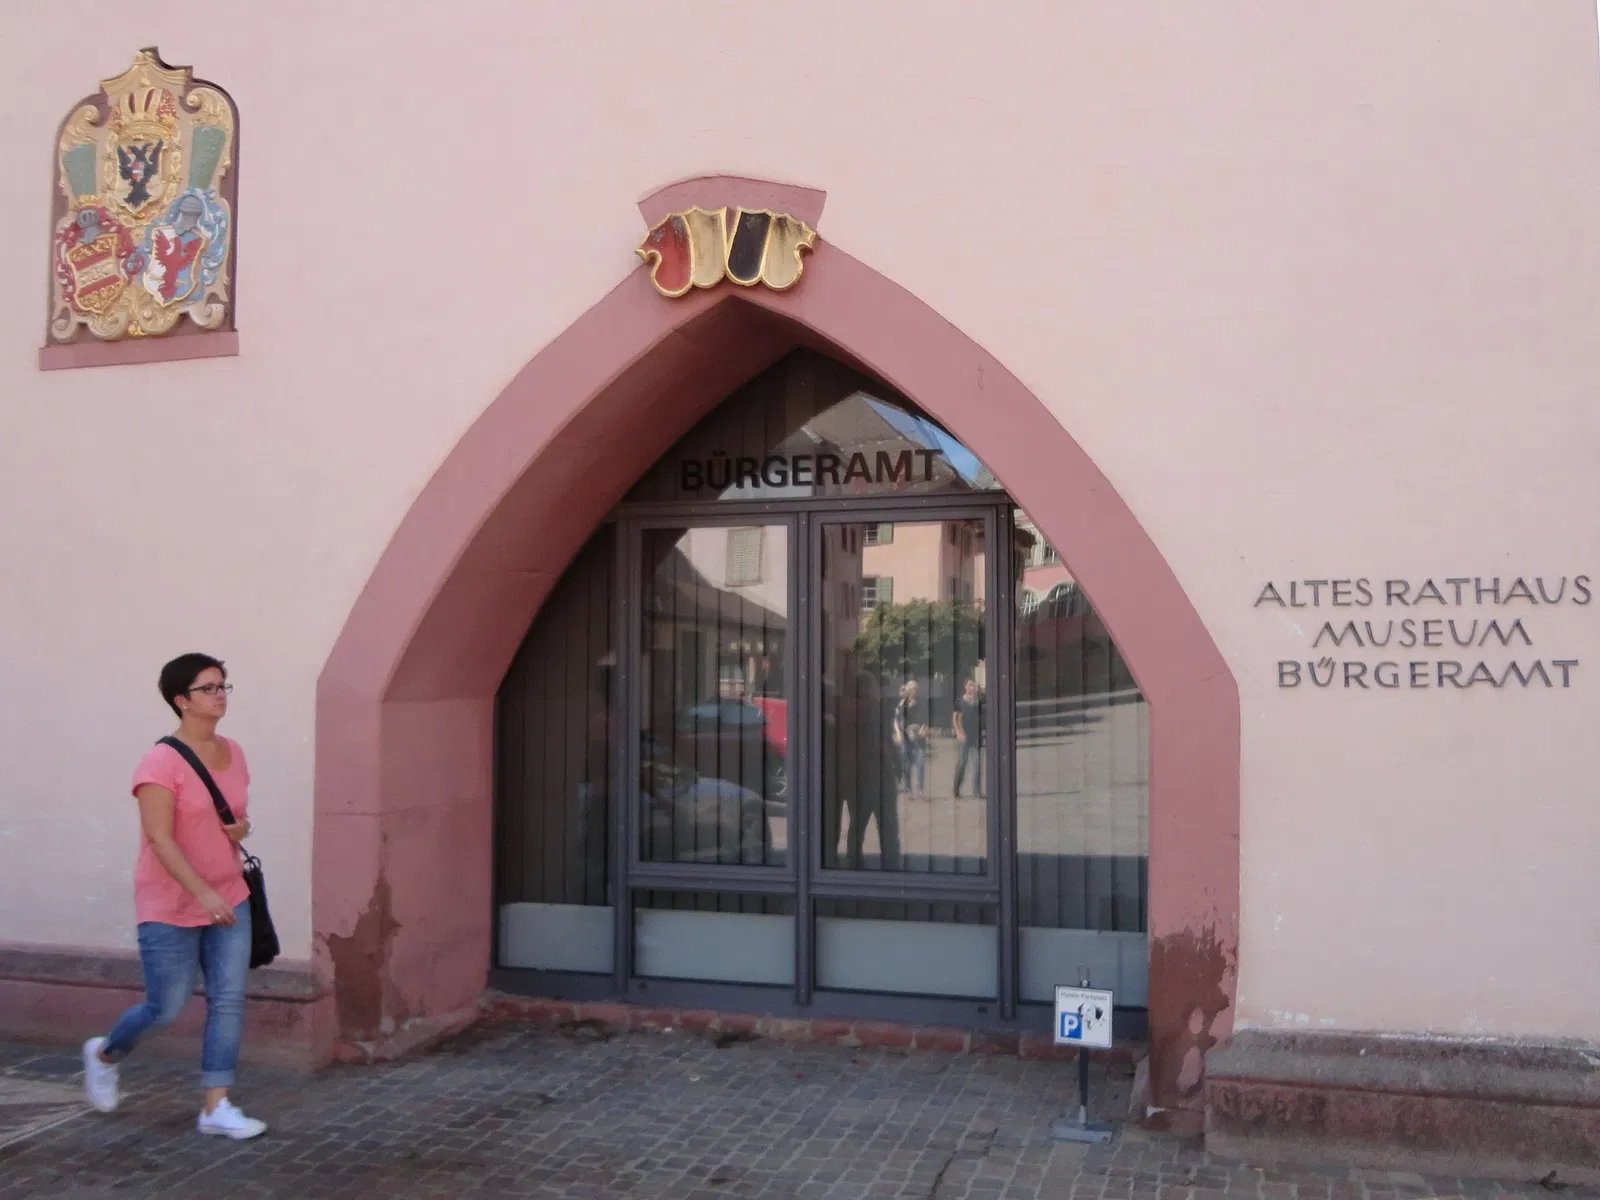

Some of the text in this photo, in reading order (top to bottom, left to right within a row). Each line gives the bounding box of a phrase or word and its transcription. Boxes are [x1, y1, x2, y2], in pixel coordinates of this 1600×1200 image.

[681, 449, 943, 491] BÜRGERAMT
[1253, 575, 1593, 608] ALTES RATHAUS
[1312, 617, 1533, 648] MUSEUM
[1277, 656, 1580, 689] BÜRGERAMT
[1064, 1014, 1079, 1036] P
